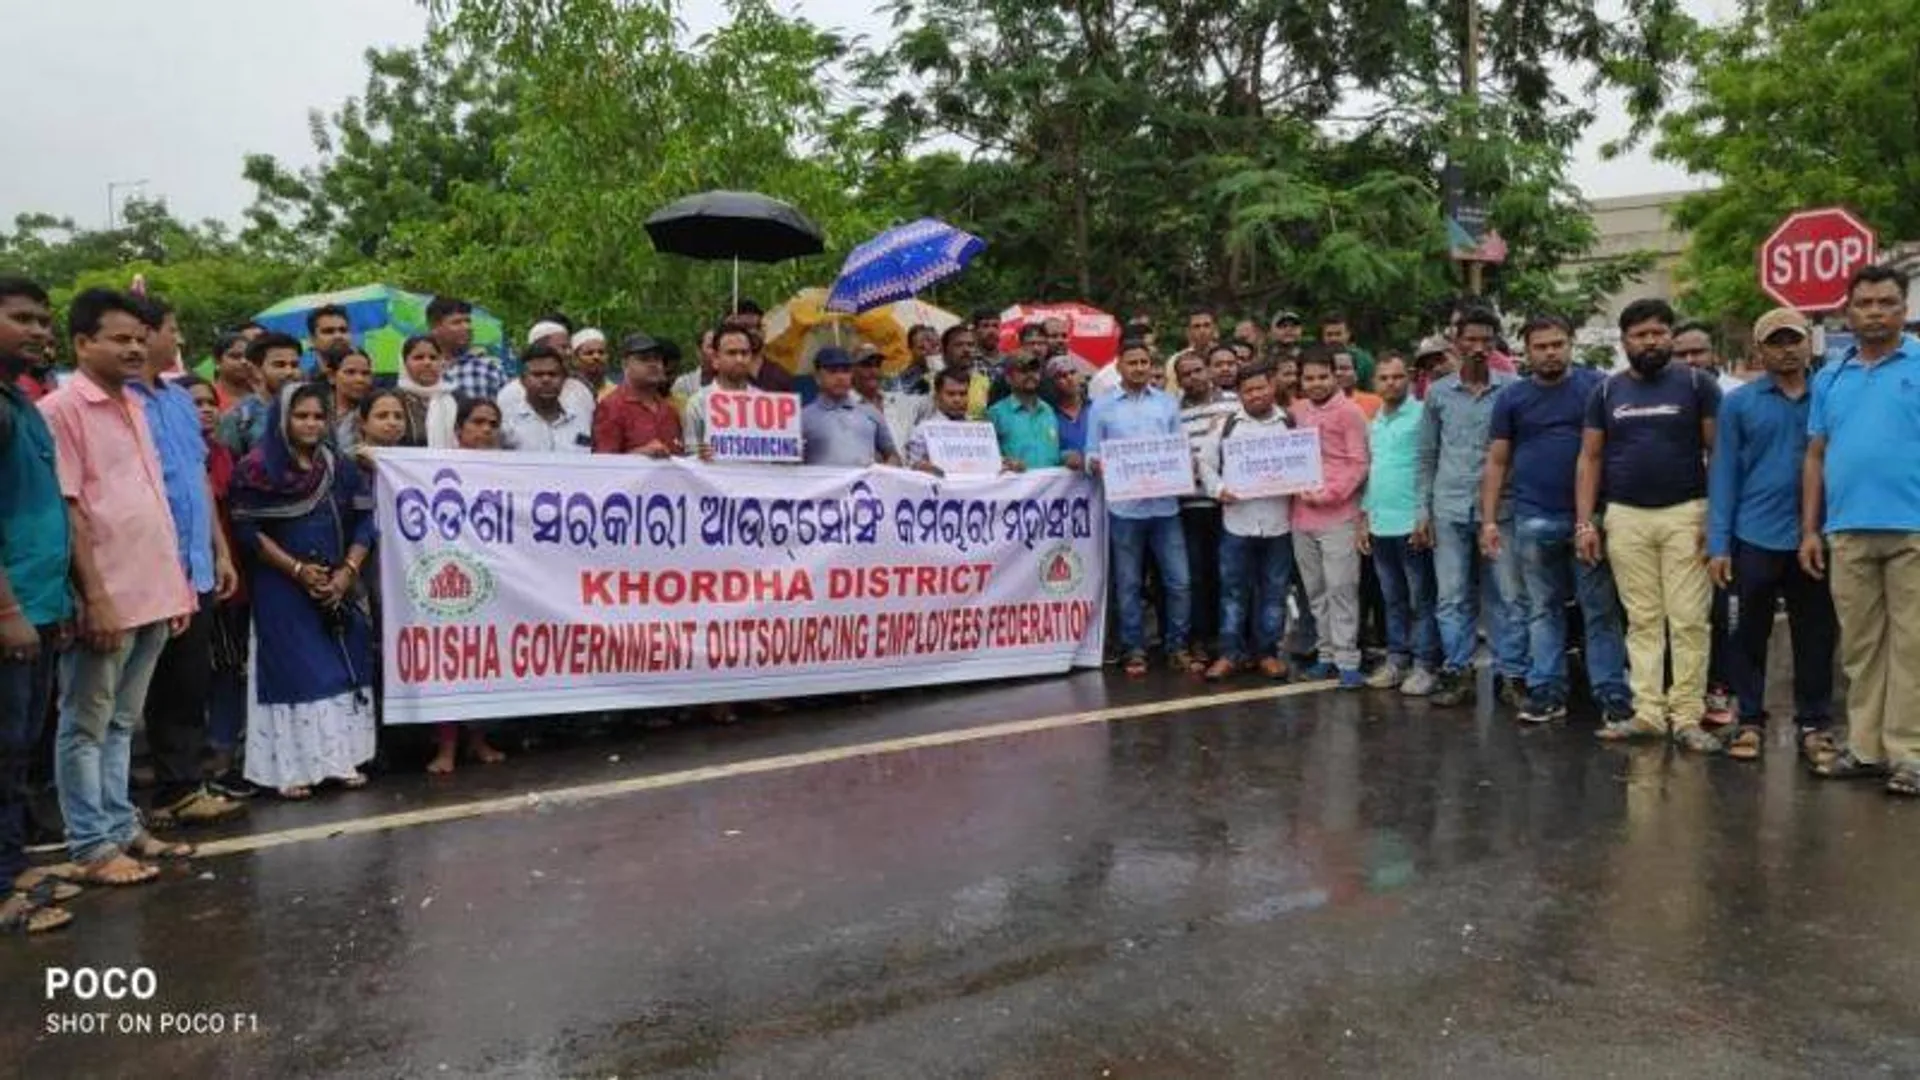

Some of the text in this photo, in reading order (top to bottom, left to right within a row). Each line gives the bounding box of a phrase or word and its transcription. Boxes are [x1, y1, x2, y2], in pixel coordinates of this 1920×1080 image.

[1772, 236, 1862, 285] STOP
[710, 392, 795, 430] STOP
[710, 433, 798, 457] OUTSOURCING
[532, 491, 687, 549] ସରକାରୀ
[581, 564, 992, 605] KHORDHA DISTRICT
[397, 624, 501, 684] ODISHA
[511, 616, 697, 678] GOVERNMENT
[706, 612, 868, 669] OUTSOURCING
[875, 606, 983, 657] EMPLOYEES
